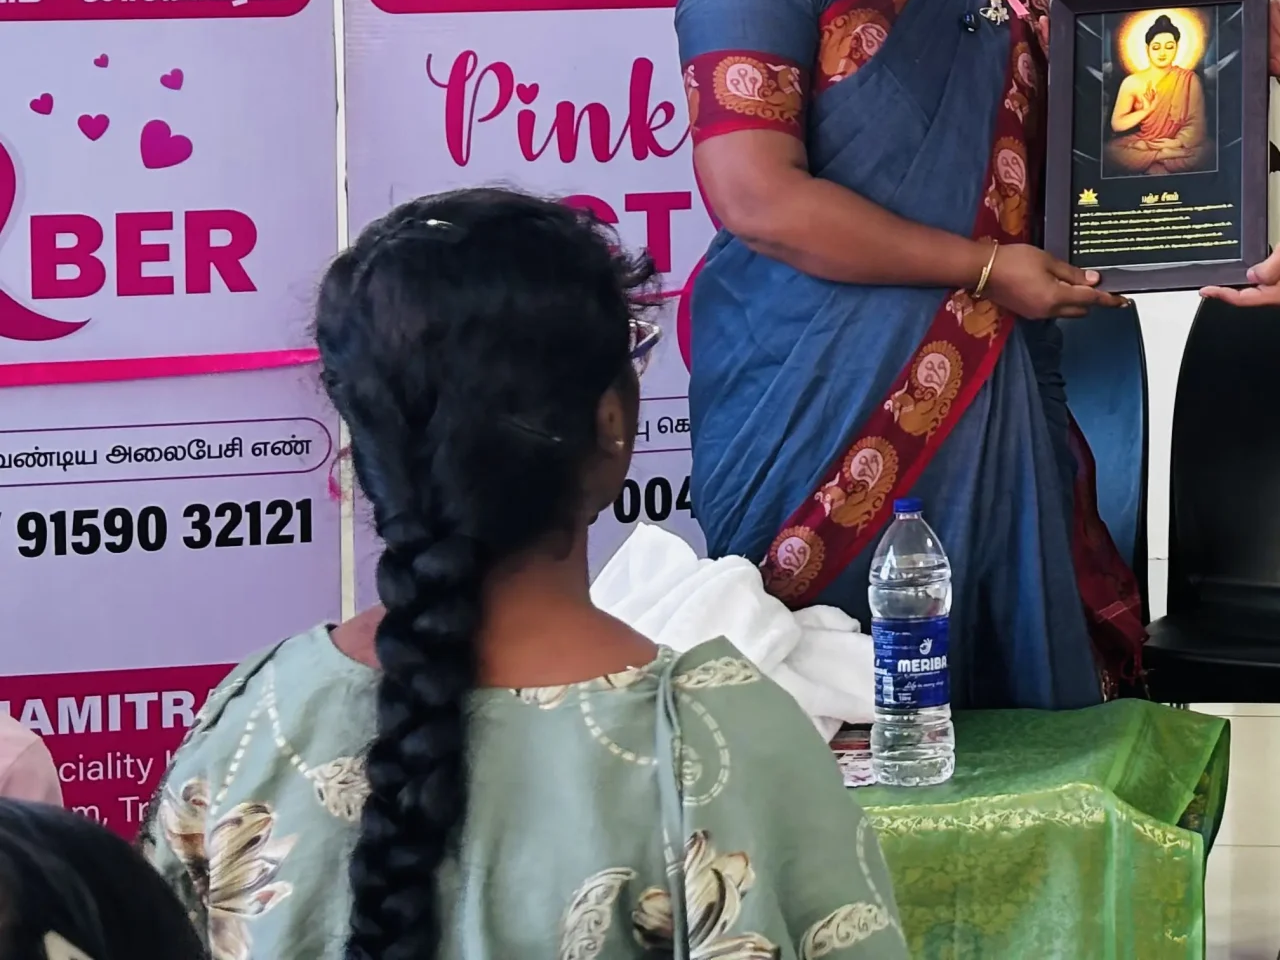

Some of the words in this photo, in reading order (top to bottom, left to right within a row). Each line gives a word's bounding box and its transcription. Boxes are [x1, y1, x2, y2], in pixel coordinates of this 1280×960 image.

[426, 50, 691, 167] Pink
[106, 439, 243, 465] அலைபேசி
[251, 434, 312, 458] எண்
[17, 506, 167, 558] 91590
[183, 498, 313, 550] 32121
[0, 689, 215, 737] AMITR
